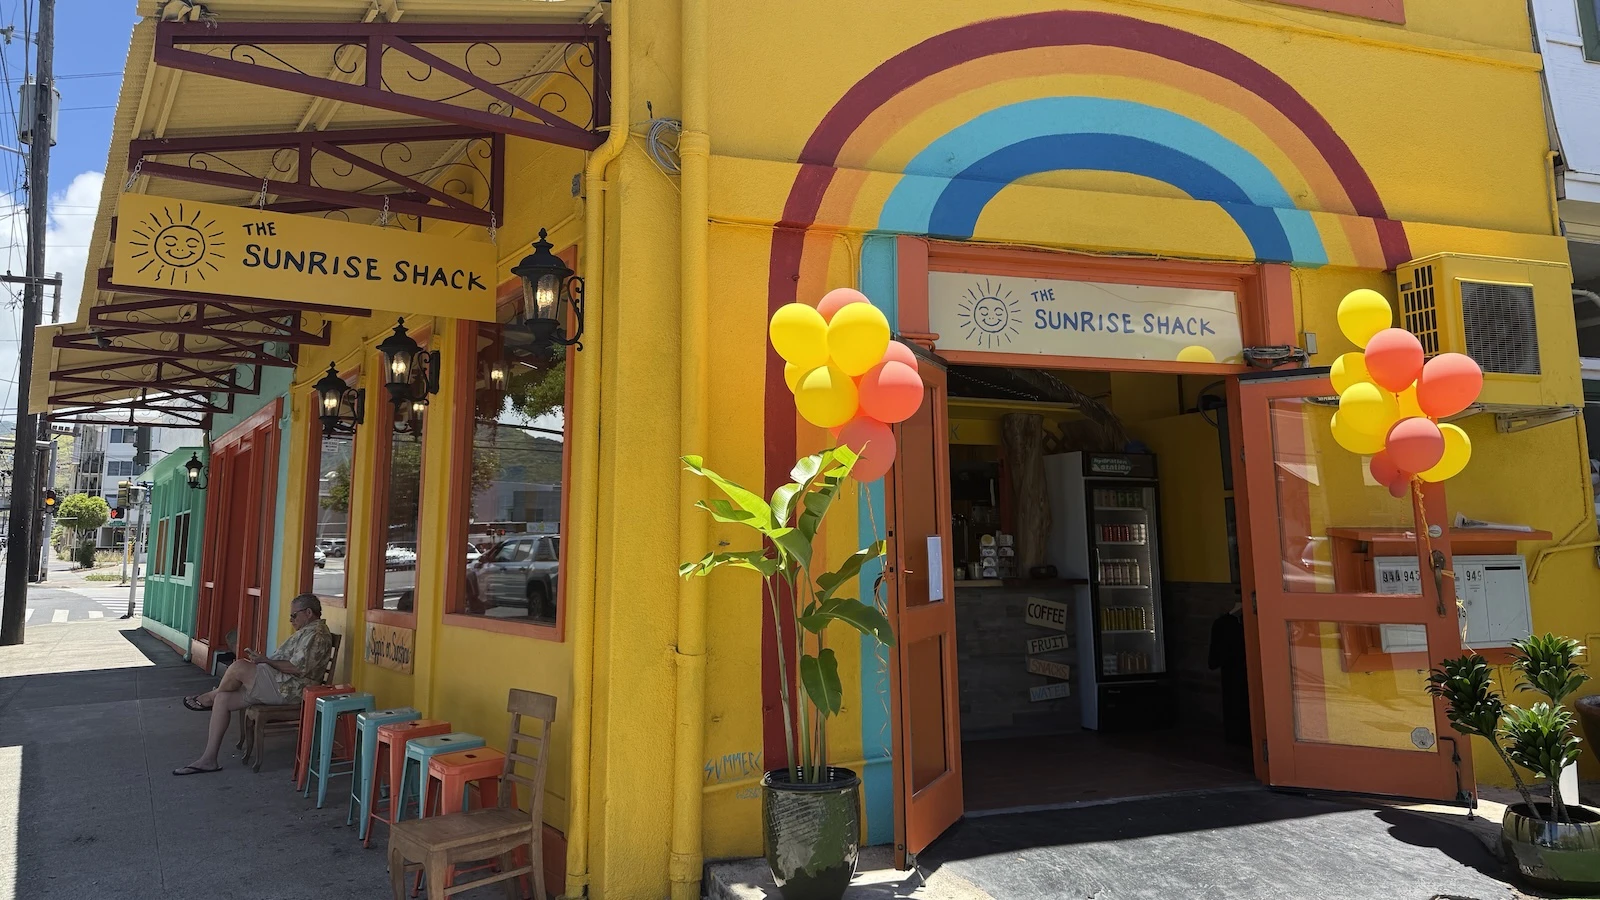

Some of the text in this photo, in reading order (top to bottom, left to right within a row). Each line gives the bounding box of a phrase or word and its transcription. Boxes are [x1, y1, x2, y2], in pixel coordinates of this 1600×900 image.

[242, 221, 277, 237] THE
[242, 243, 487, 291] SUNRISE SHACK
[1030, 288, 1056, 302] THE
[1034, 308, 1216, 337] SUNRISE SHACK
[1100, 463, 1132, 471] station
[1027, 603, 1065, 625] COFFEE
[1031, 636, 1065, 653] FRUIT
[1031, 659, 1067, 679] SNACKS
[1031, 684, 1067, 700] WATER
